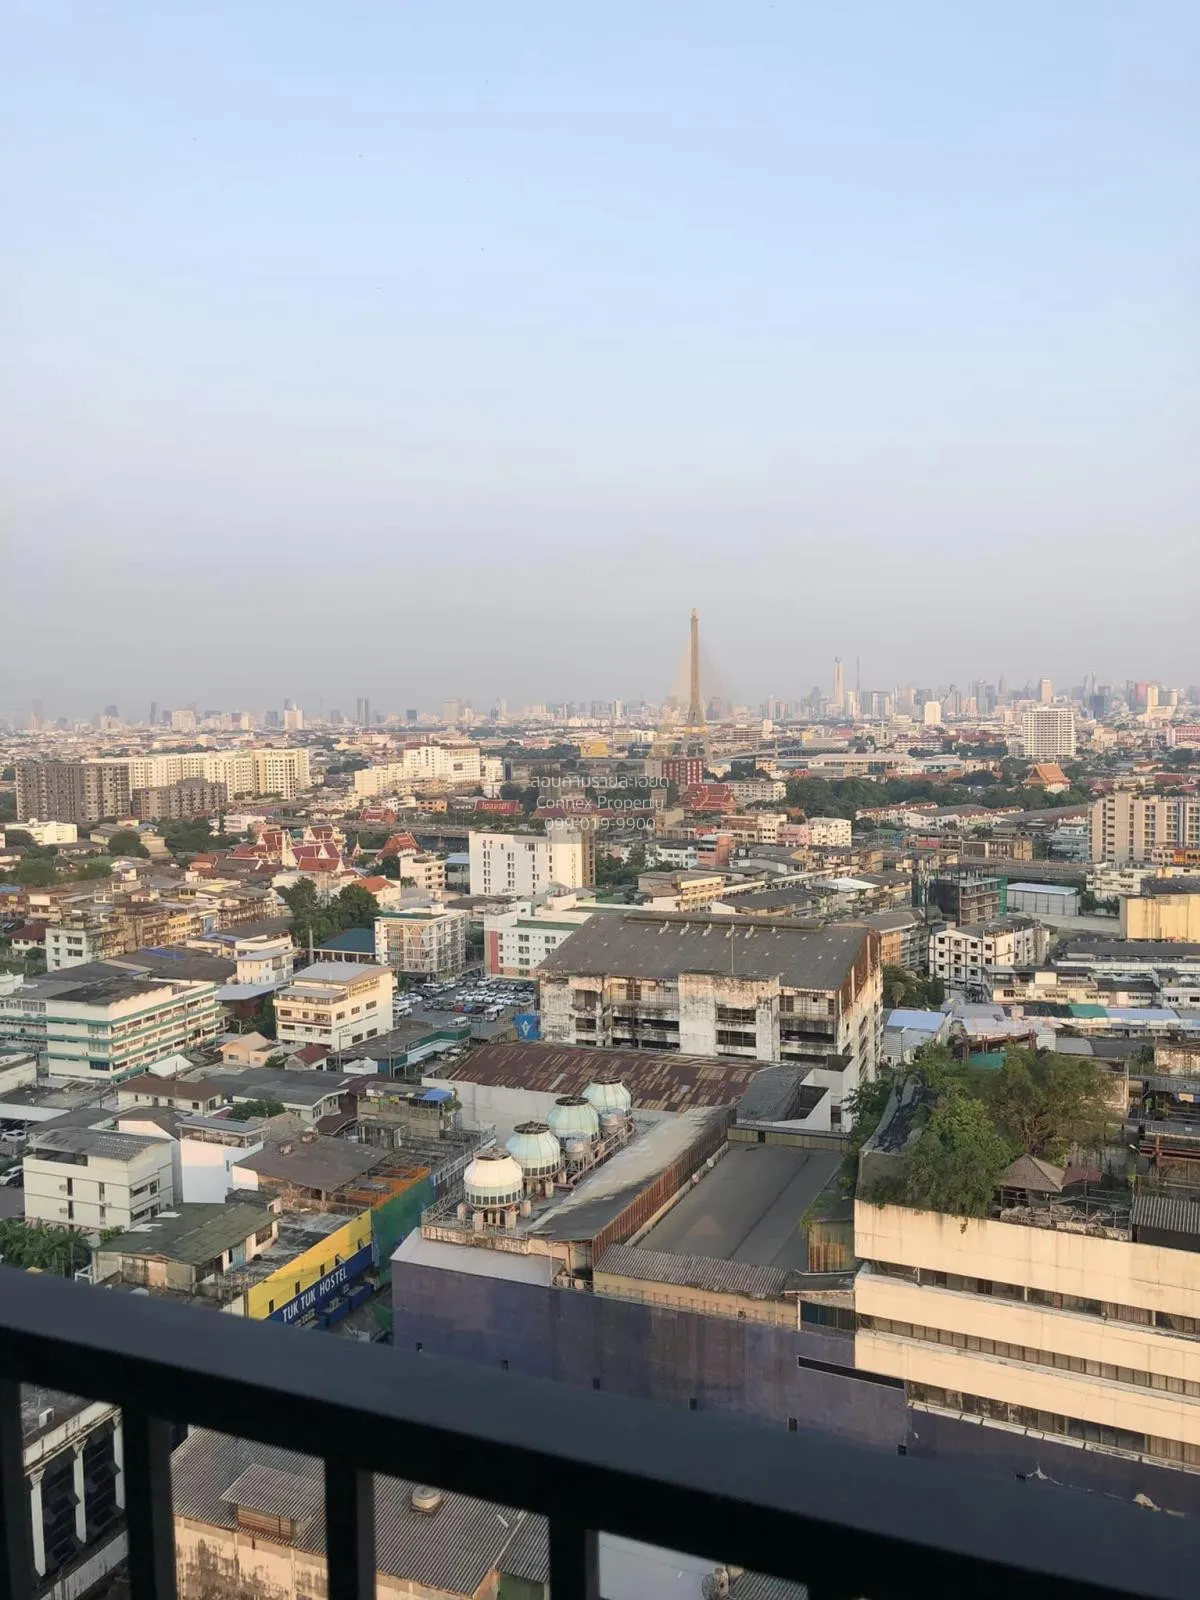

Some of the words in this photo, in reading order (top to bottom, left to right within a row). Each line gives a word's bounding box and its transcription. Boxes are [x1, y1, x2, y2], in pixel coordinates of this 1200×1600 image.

[282, 1301, 298, 1323] TUK
[301, 1288, 316, 1309] TUK
[319, 1267, 346, 1296] HOSTEL
